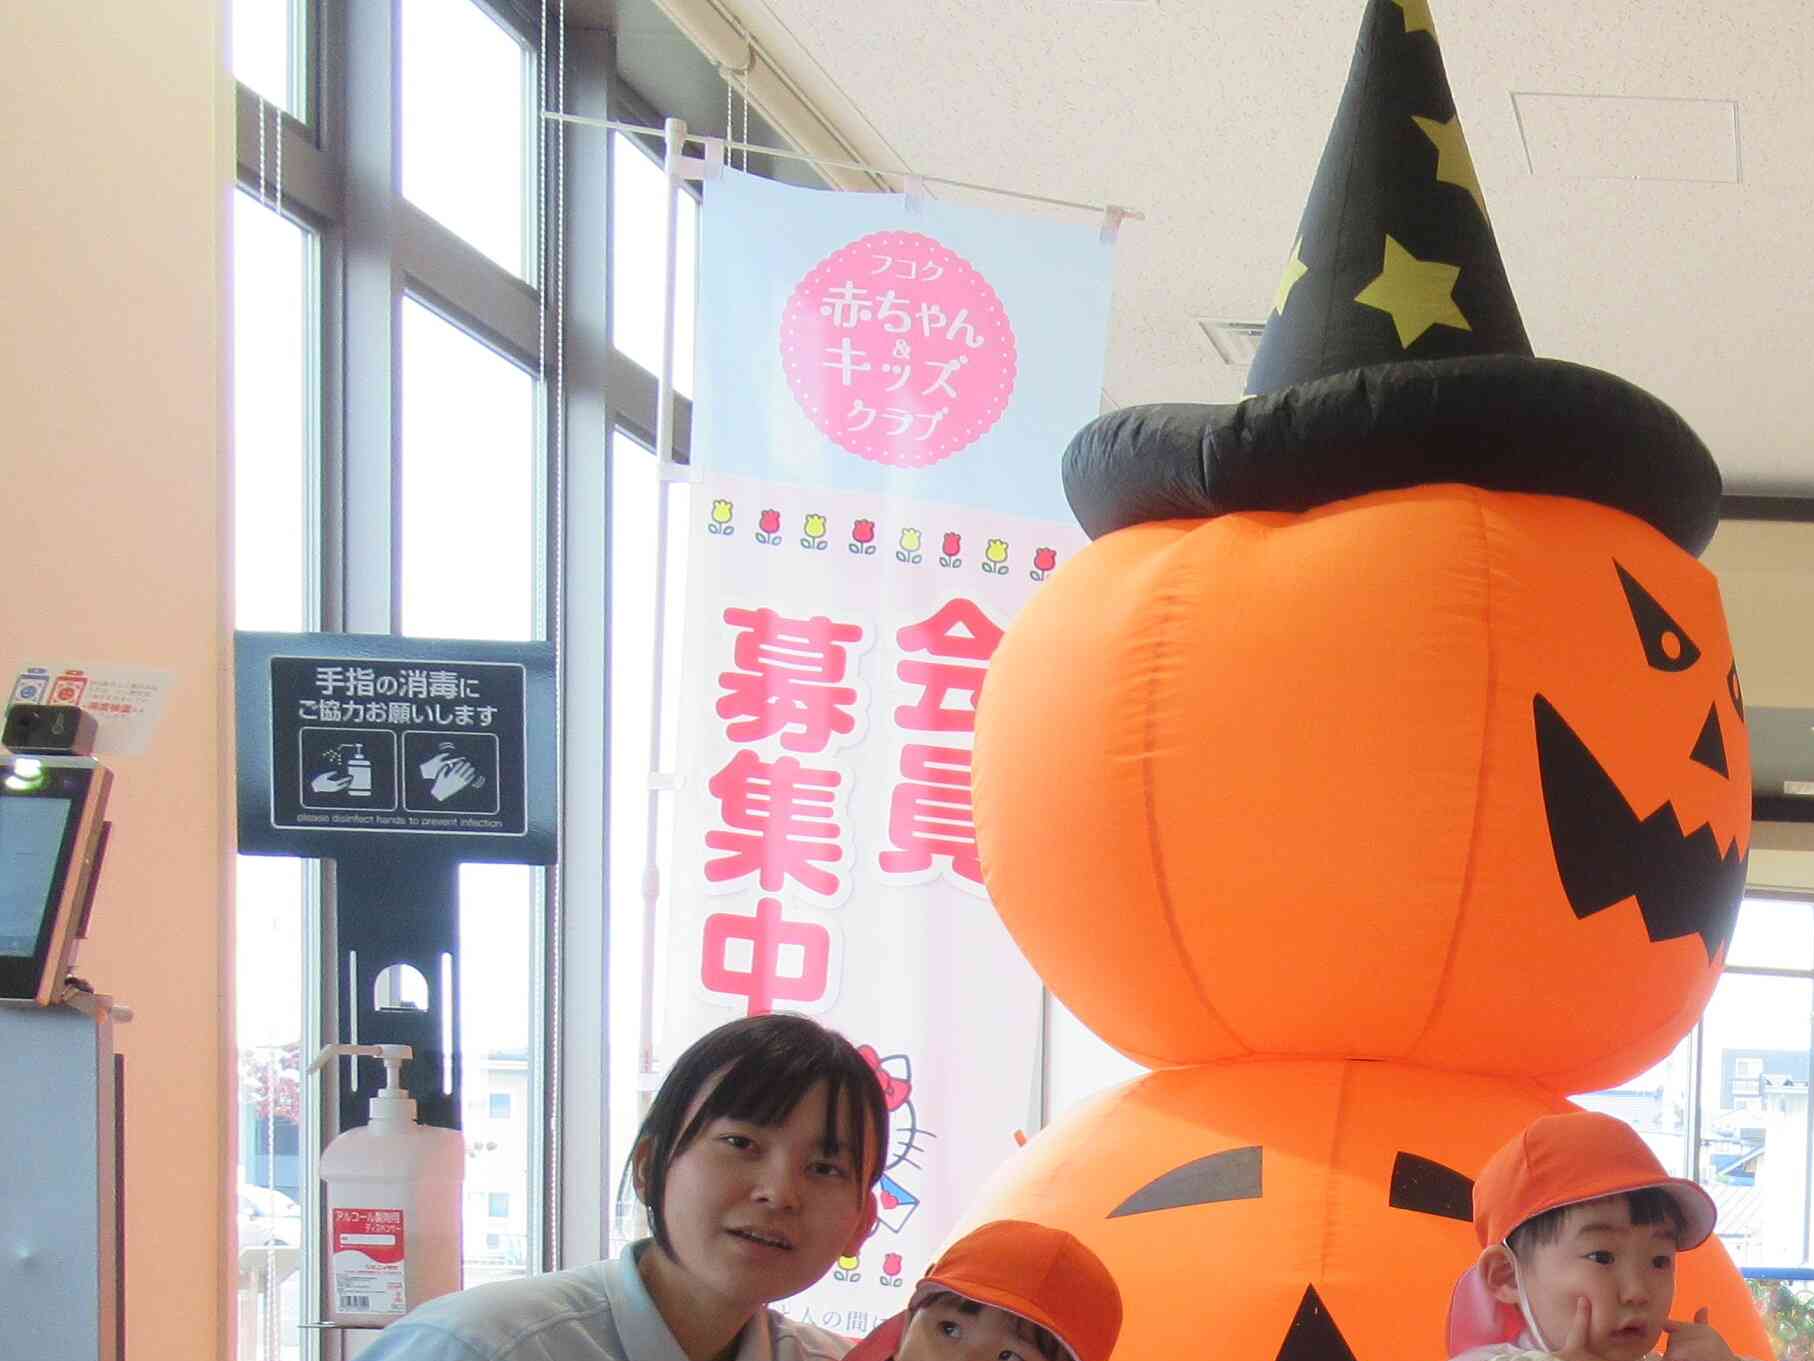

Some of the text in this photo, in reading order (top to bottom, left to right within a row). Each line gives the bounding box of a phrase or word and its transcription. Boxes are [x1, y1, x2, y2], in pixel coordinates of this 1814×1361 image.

[871, 254, 944, 281] フコク
[820, 280, 985, 348] 赤ちゃん
[822, 336, 969, 398] キッズ
[892, 338, 912, 360] &
[847, 399, 949, 441] クラブ
[315, 667, 481, 699] 手指の消毒に
[298, 698, 498, 727] ご協力お願いします
[879, 597, 1006, 887] 会員
[408, 817, 418, 826] to
[460, 818, 503, 829] infection
[701, 607, 863, 1017] 募集中
